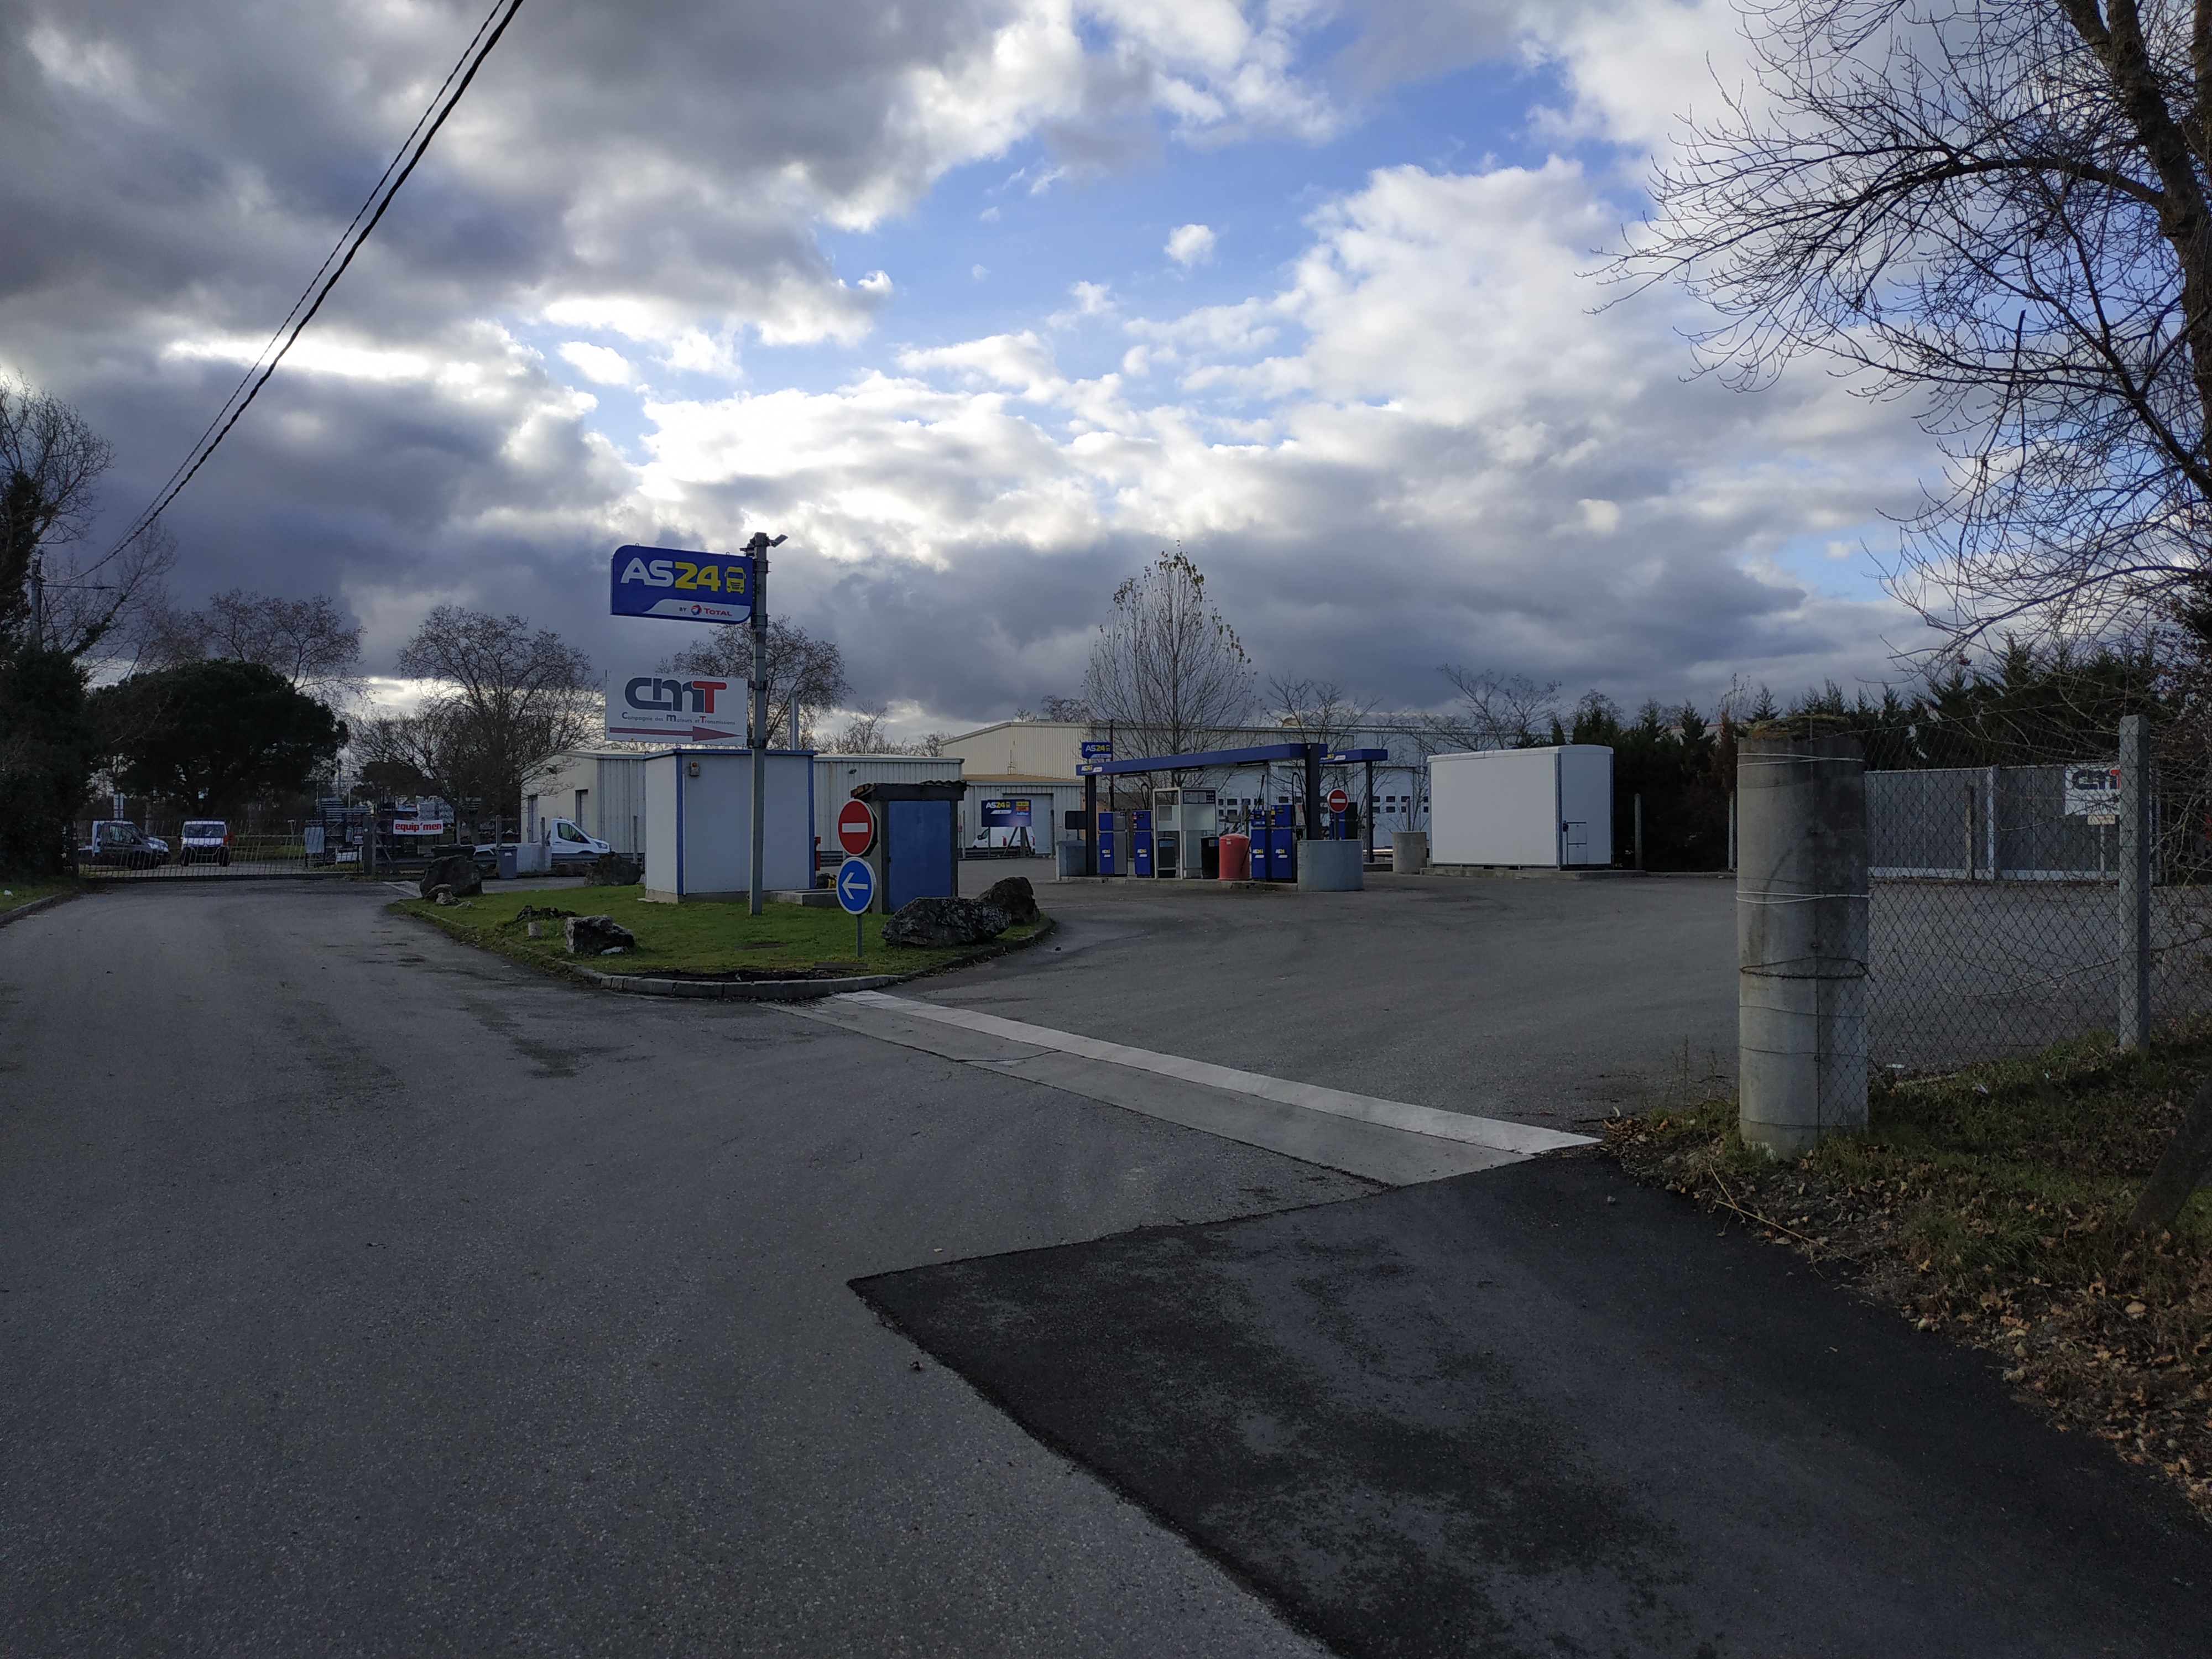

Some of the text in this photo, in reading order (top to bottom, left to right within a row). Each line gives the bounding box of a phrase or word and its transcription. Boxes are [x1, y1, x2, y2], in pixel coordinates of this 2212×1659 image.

[620, 557, 721, 592] AS24
[703, 608, 733, 617] TOTAL
[622, 711, 653, 722] Compagnie
[700, 716, 735, 725] Transmissions
[395, 822, 442, 833] equip'men
